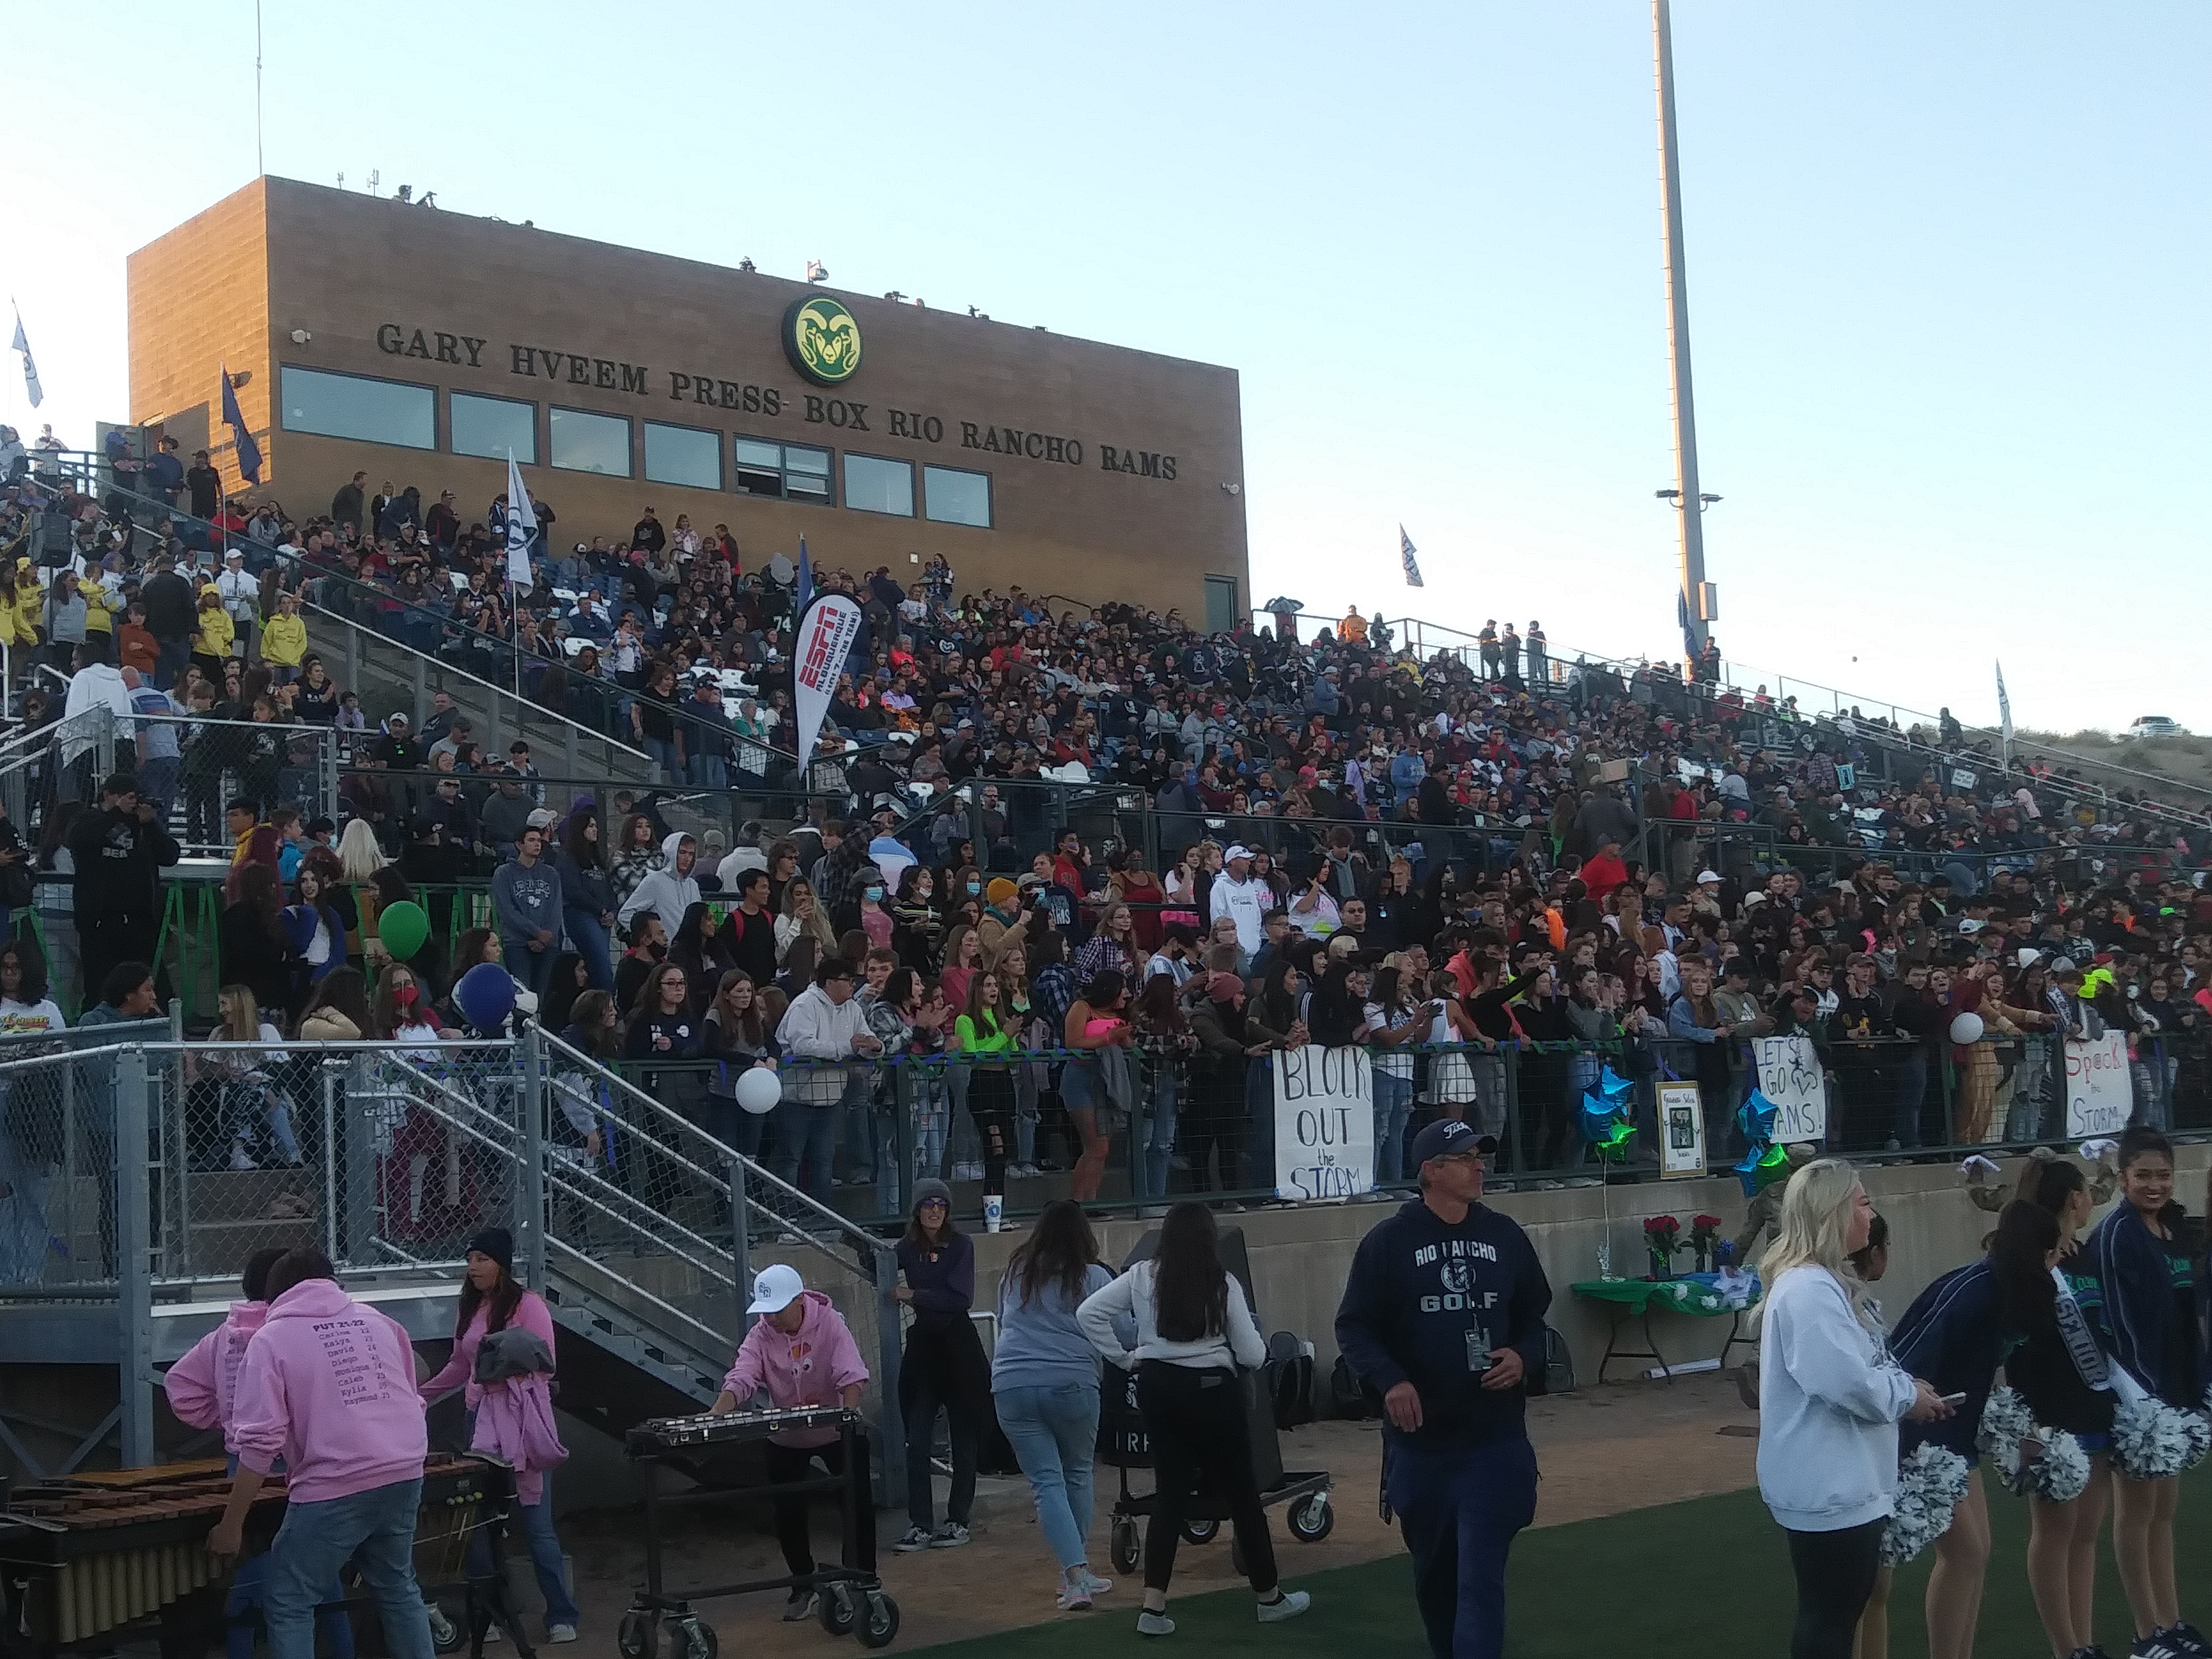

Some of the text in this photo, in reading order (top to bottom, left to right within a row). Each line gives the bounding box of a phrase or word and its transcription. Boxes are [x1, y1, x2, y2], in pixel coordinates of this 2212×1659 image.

[376, 323, 1177, 481] GARY HVEEM PRESS BOX RIO RANCHO RAMS
[773, 615, 792, 633] 74
[815, 610, 848, 692] ALBUQUERQUE
[1280, 1045, 1371, 1102] BLOCK
[1765, 1067, 1786, 1096] GO
[1296, 1107, 1352, 1147] OUT
[1776, 1103, 1822, 1136] AMS!
[1318, 1148, 1335, 1166] the
[1290, 1167, 1362, 1200] STORM
[1415, 1244, 1437, 1267] RIO
[1420, 1292, 1498, 1312] GOLF
[327, 1345, 355, 1358] David
[2056, 1298, 2109, 1385] SENIOR
